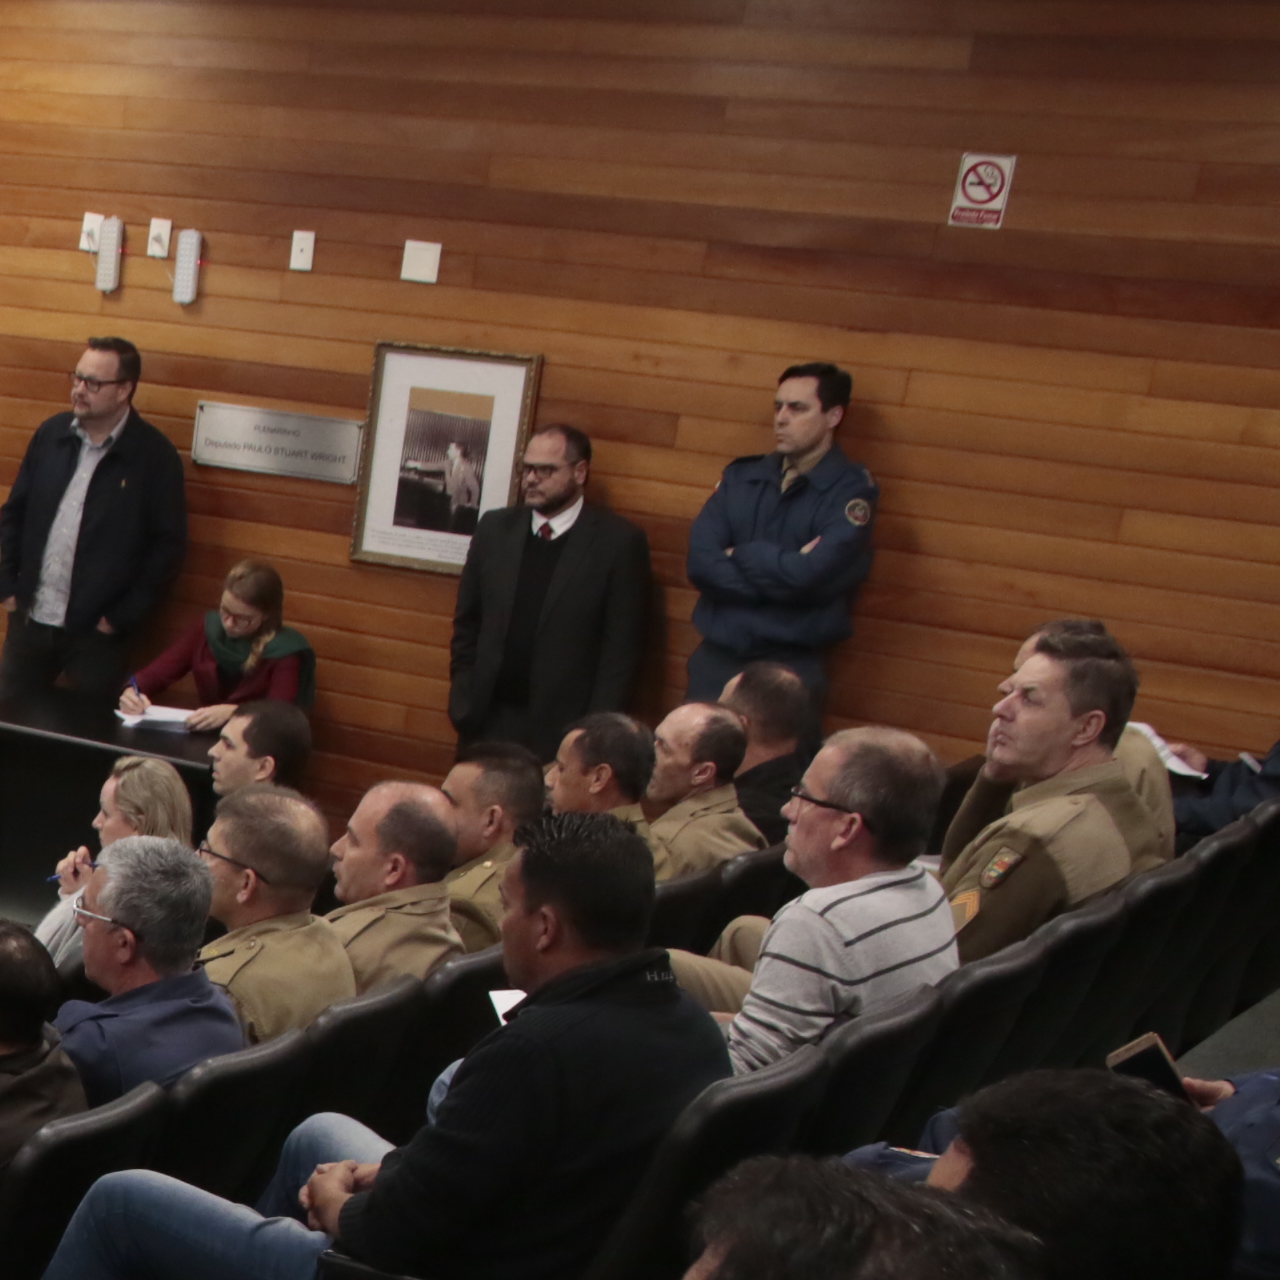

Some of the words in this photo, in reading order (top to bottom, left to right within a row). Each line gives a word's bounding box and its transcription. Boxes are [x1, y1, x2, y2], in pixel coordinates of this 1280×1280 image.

[204, 437, 241, 450] Deputado
[243, 442, 272, 454] PAULO
[273, 446, 308, 458] STUART
[310, 450, 347, 464] WRIGHT
